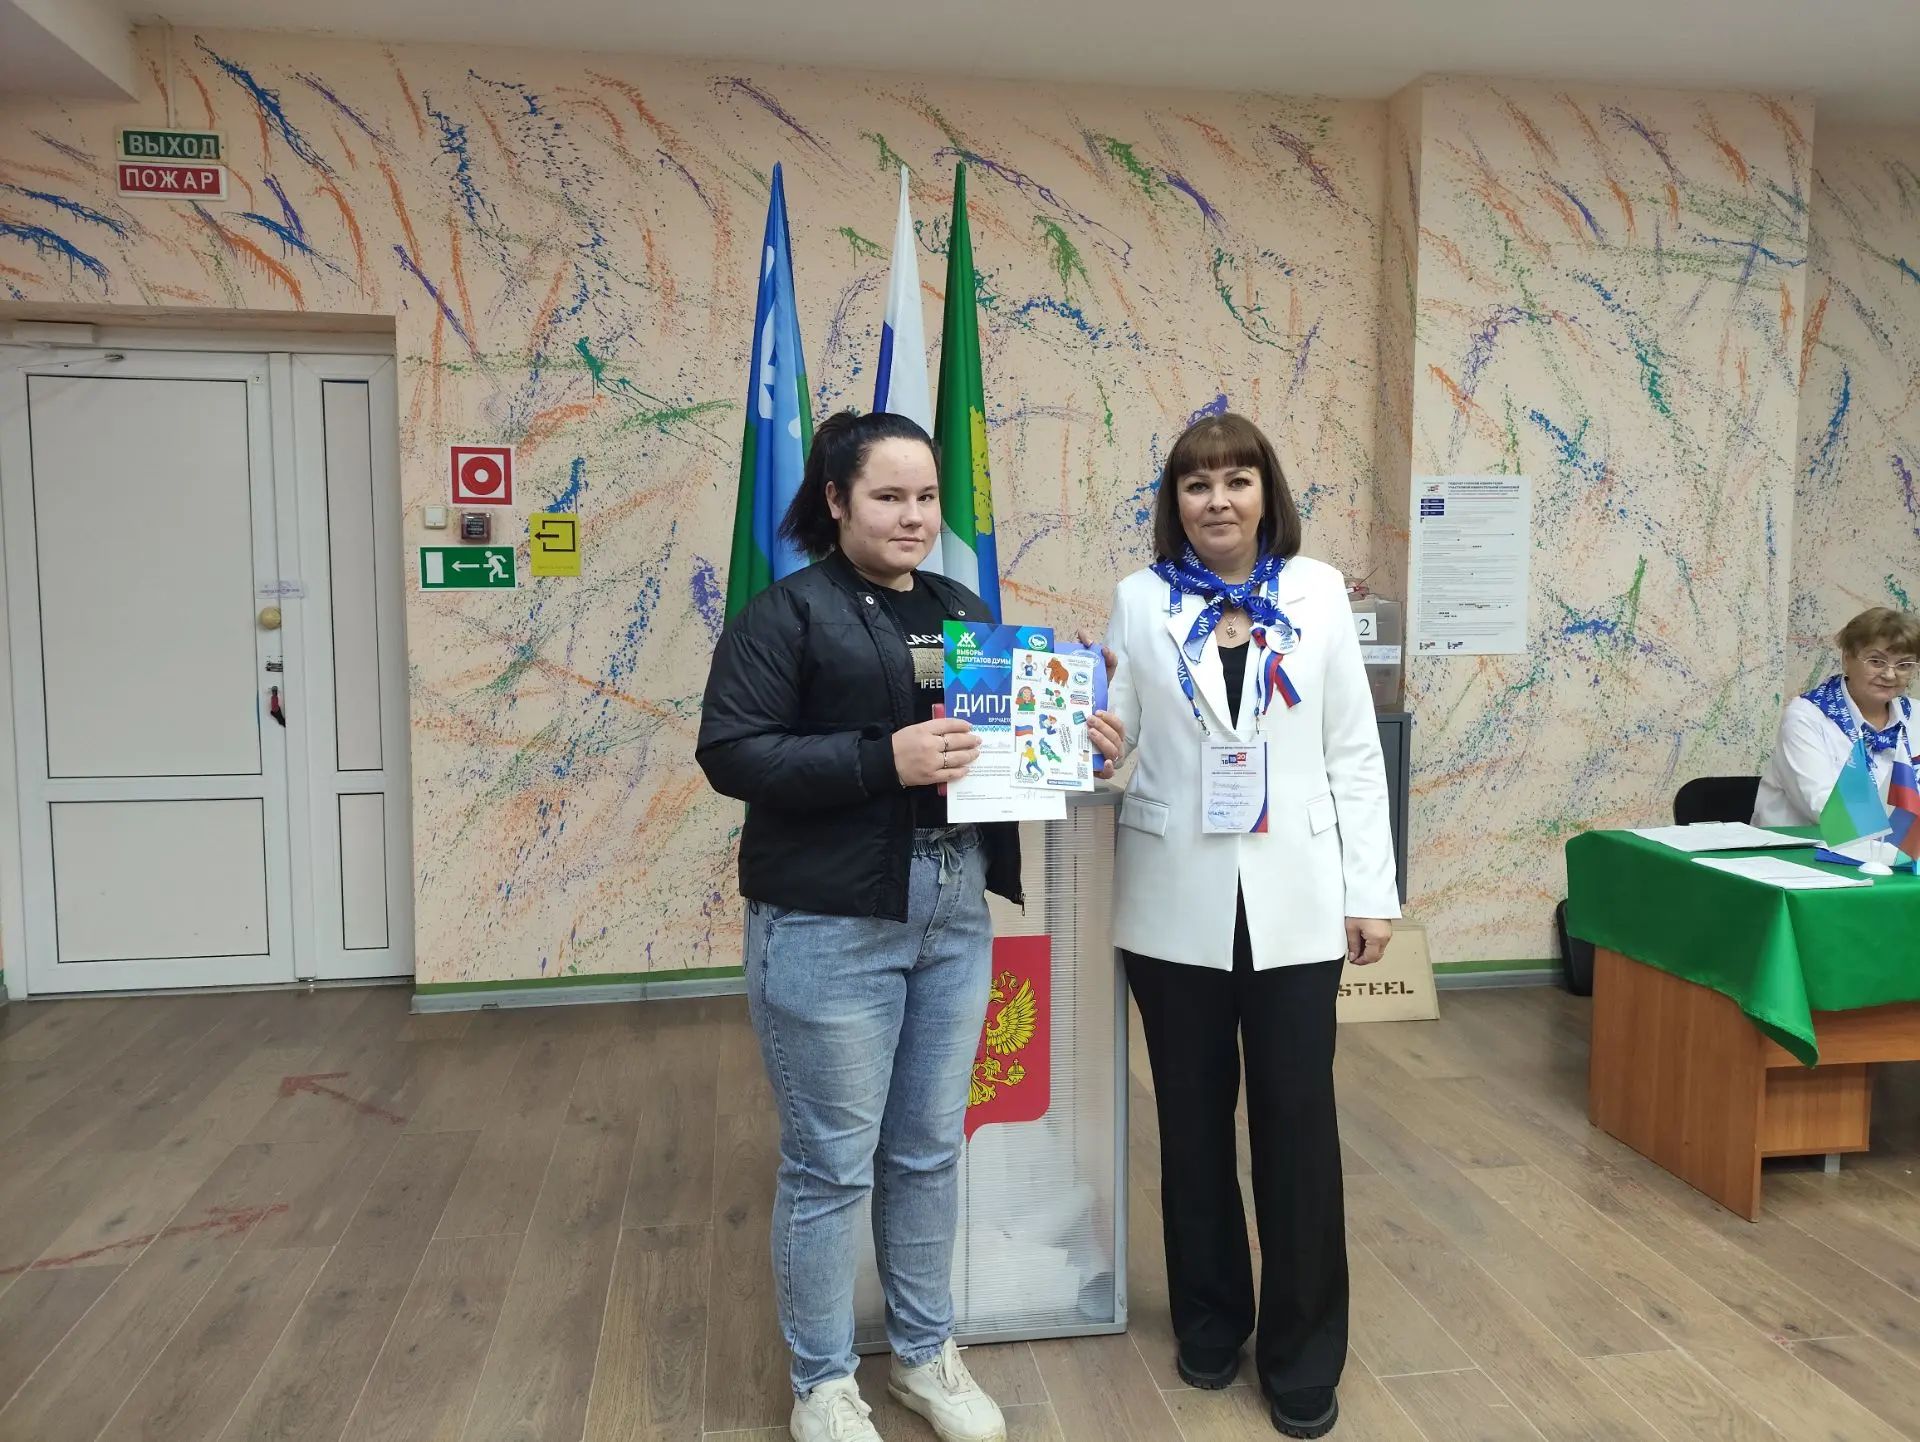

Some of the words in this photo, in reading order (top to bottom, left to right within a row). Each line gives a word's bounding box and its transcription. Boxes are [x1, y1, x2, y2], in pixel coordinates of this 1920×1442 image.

[128, 134, 217, 159] ВЫХОД
[125, 168, 214, 190] ПОЖАР
[1359, 618, 1371, 636] 2
[956, 656, 991, 664] ДЕПУТАТОВ
[991, 657, 1011, 665] ДУМЫ
[1338, 980, 1415, 997] STEEL
